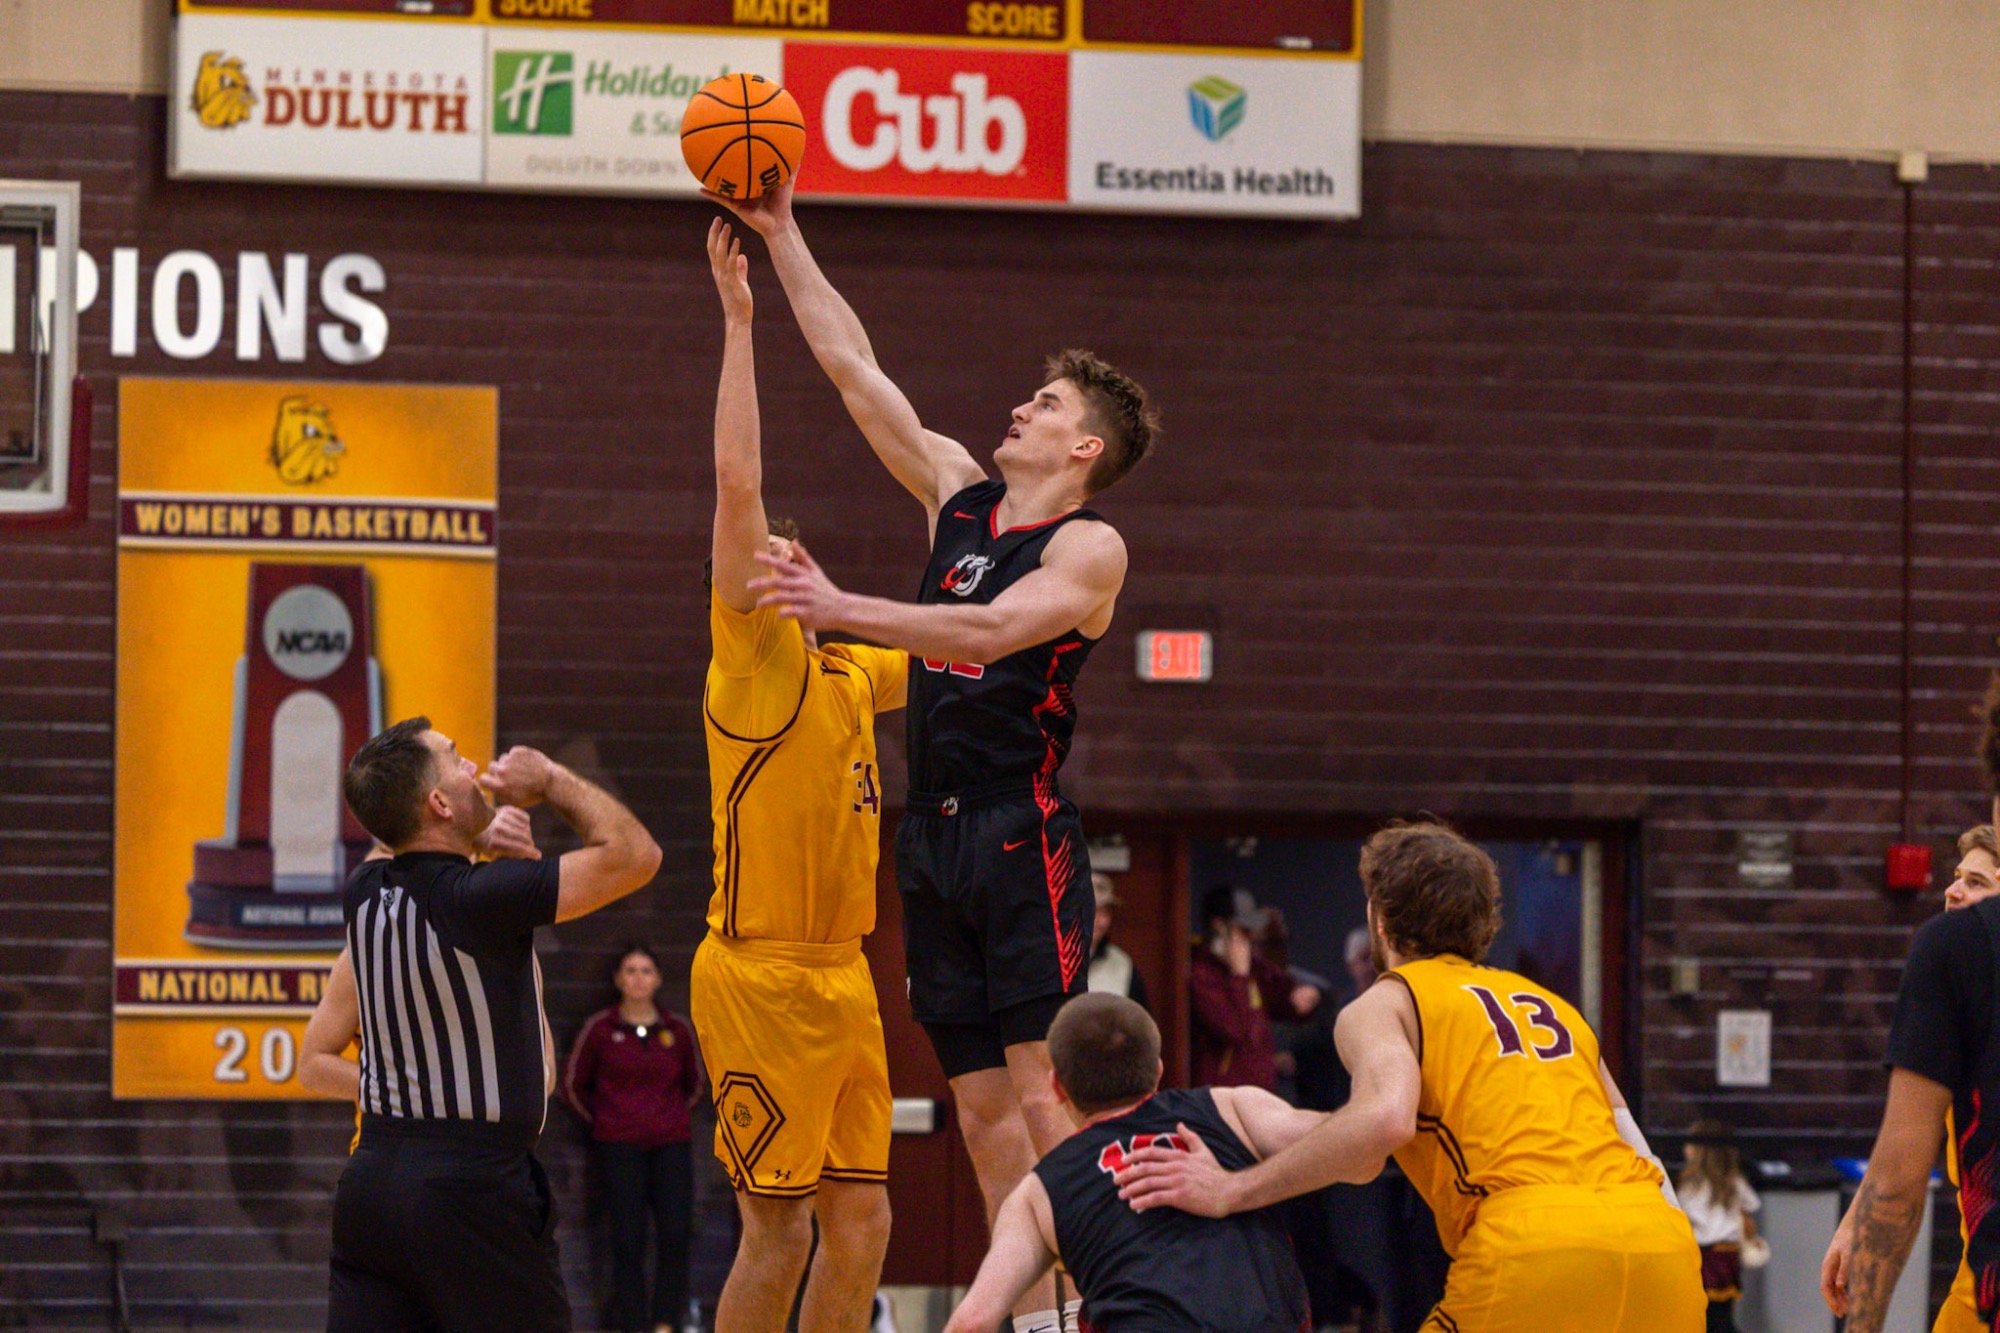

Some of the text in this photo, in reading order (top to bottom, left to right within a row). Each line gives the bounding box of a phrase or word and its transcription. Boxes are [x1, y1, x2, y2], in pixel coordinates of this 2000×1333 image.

[733, 0, 829, 26] MATCH
[967, 2, 1060, 36] SCORE
[265, 67, 468, 90] MINNESOTA
[264, 86, 469, 133] DULUTH
[822, 66, 1027, 176] Cub
[1095, 161, 1335, 197] Essentia Health
[0, 244, 390, 364] PIONS
[135, 503, 487, 542] WOMEN'S BASKETBALL
[275, 629, 346, 656] NCAA
[139, 971, 288, 1002] NATIONAL
[1459, 985, 1574, 1062] 13
[213, 1026, 296, 1082] 20
